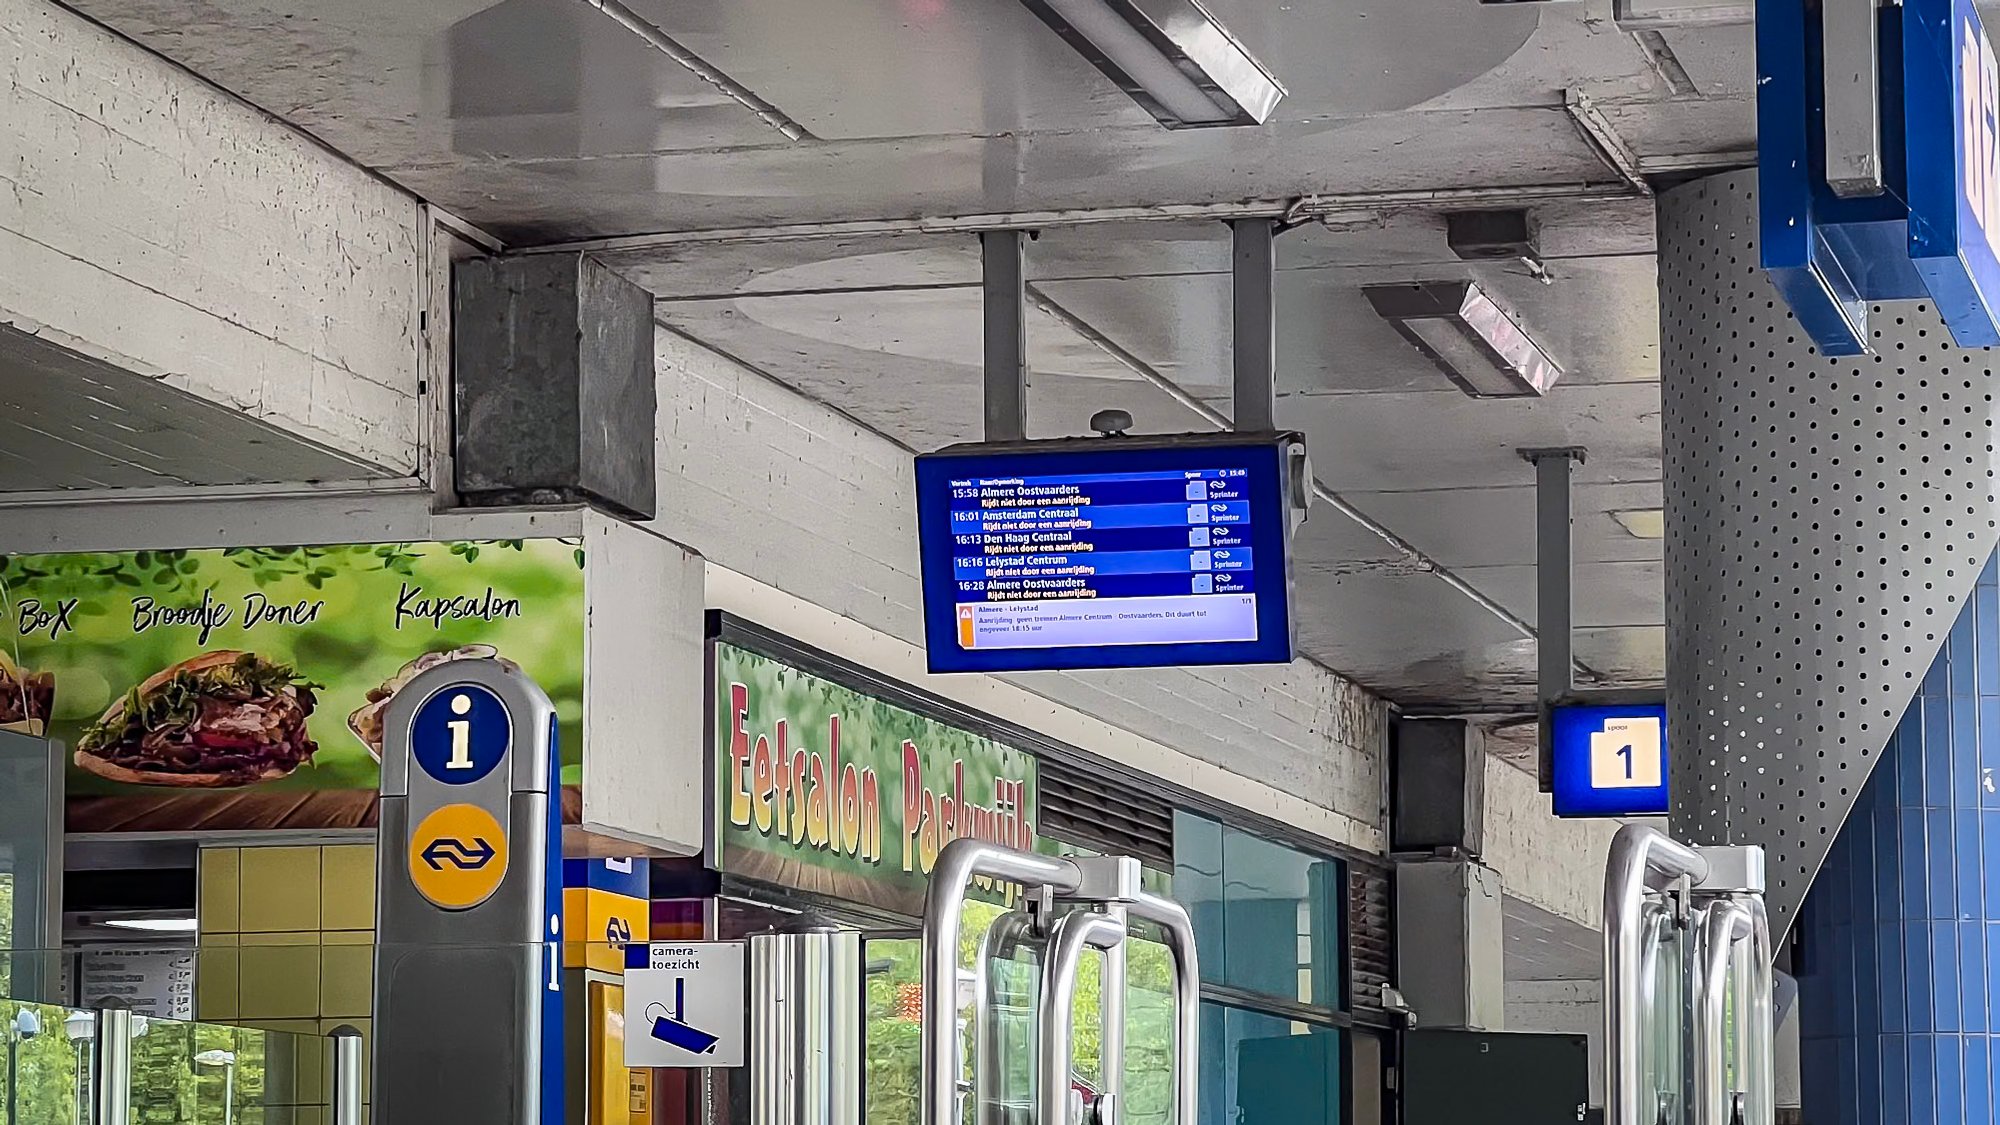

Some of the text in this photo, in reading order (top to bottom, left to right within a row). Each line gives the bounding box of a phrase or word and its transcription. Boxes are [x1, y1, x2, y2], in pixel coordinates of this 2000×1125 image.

[953, 484, 1080, 498] 15:58 Almere Oostvaarders
[1209, 491, 1239, 500] Sprinter
[981, 499, 1000, 509] Rijdt
[1000, 498, 1016, 507] niet
[1017, 497, 1035, 506] door
[1052, 496, 1091, 506] aanrijding
[954, 507, 1079, 522] 16:01 Amsterdam Centraal
[1211, 514, 1240, 523] Sprinter
[982, 522, 1001, 532] Rijdt
[1002, 521, 1018, 530] niet
[1019, 520, 1036, 529] door
[1054, 519, 1092, 529] aanrijding
[956, 531, 1072, 545] 16:13 Den Haag Centraal
[1212, 537, 1241, 546] Sprinter
[984, 545, 1003, 555] Rijdt
[1003, 544, 1019, 553] niet
[1020, 543, 1038, 552] door
[1055, 542, 1094, 552] aanrijding
[957, 555, 1068, 568] 16:16 Lelystad Centrum
[1214, 560, 1243, 569] Sprinter
[985, 568, 1004, 578] Rijdt
[1005, 567, 1021, 576] niet
[1022, 567, 1040, 575] door
[1056, 565, 1095, 576] aanrijding
[958, 577, 1086, 591] 16:28 Almere Oostvaarders
[1215, 584, 1244, 593] Sprinter
[987, 591, 1006, 602] Rijdt
[1006, 590, 1022, 599] niet
[1023, 589, 1041, 598] door
[1057, 588, 1097, 599] aanrijding
[395, 582, 521, 630] Kapsalon
[1009, 604, 1039, 613] Lelystad
[131, 588, 325, 647] Broodje Doner
[1616, 744, 1632, 779] 1
[730, 681, 881, 863] Eetsalon
[652, 947, 698, 956] camera-
[652, 958, 700, 970] toezicht
